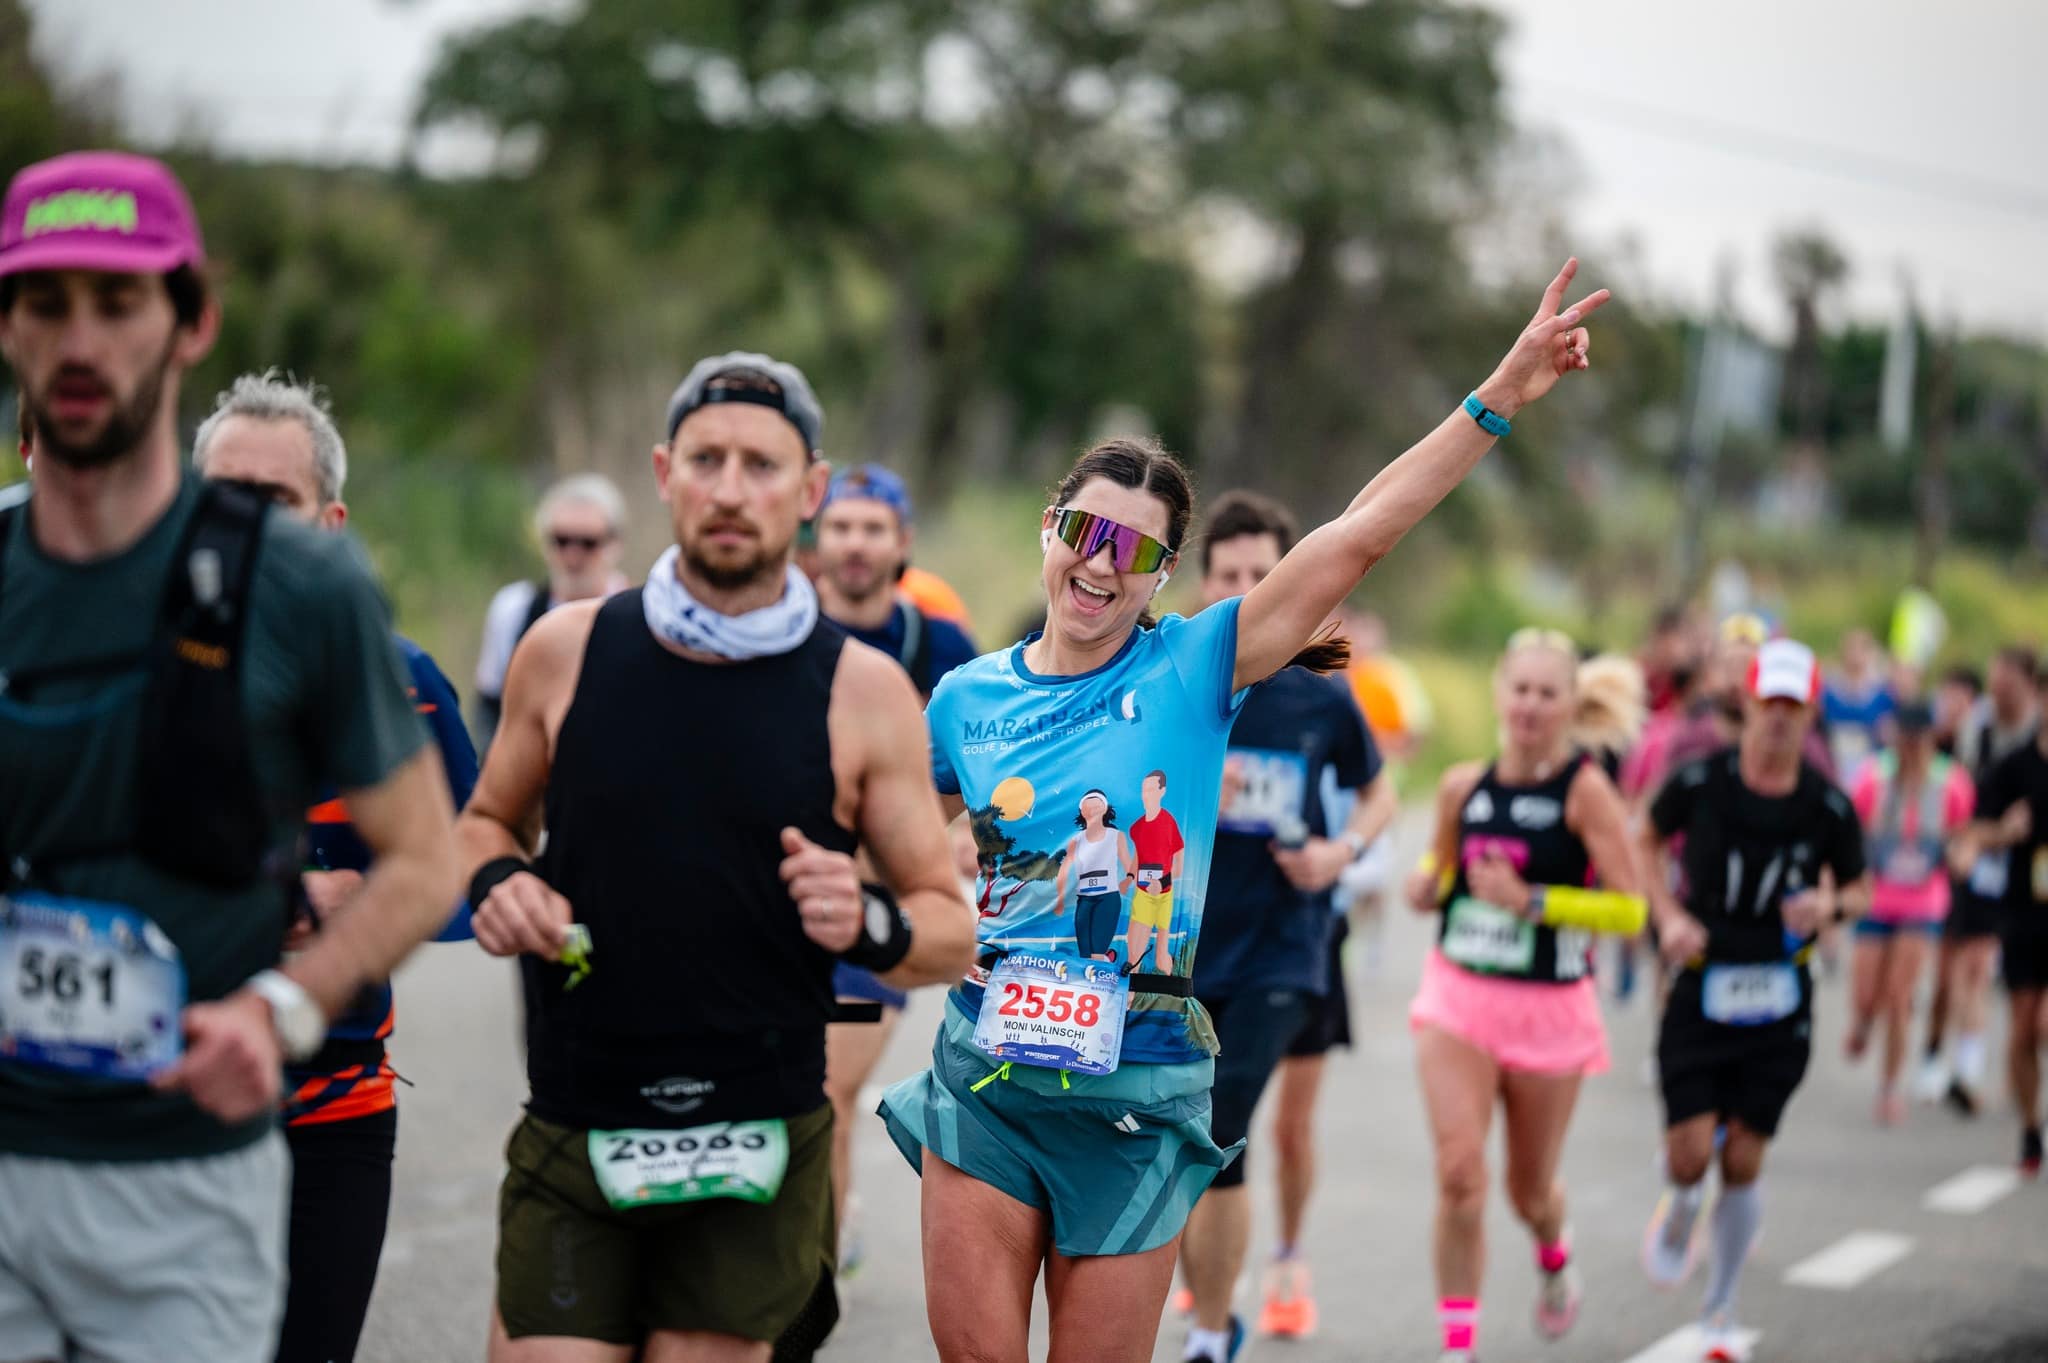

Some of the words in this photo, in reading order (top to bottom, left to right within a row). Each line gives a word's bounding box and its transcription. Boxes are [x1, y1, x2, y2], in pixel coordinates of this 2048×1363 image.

[963, 743, 996, 755] GOLFE
[18, 946, 115, 1009] 561
[998, 982, 1101, 1027] 2558
[1004, 1020, 1028, 1032] MONI
[1030, 1023, 1086, 1040] VALINSCHI
